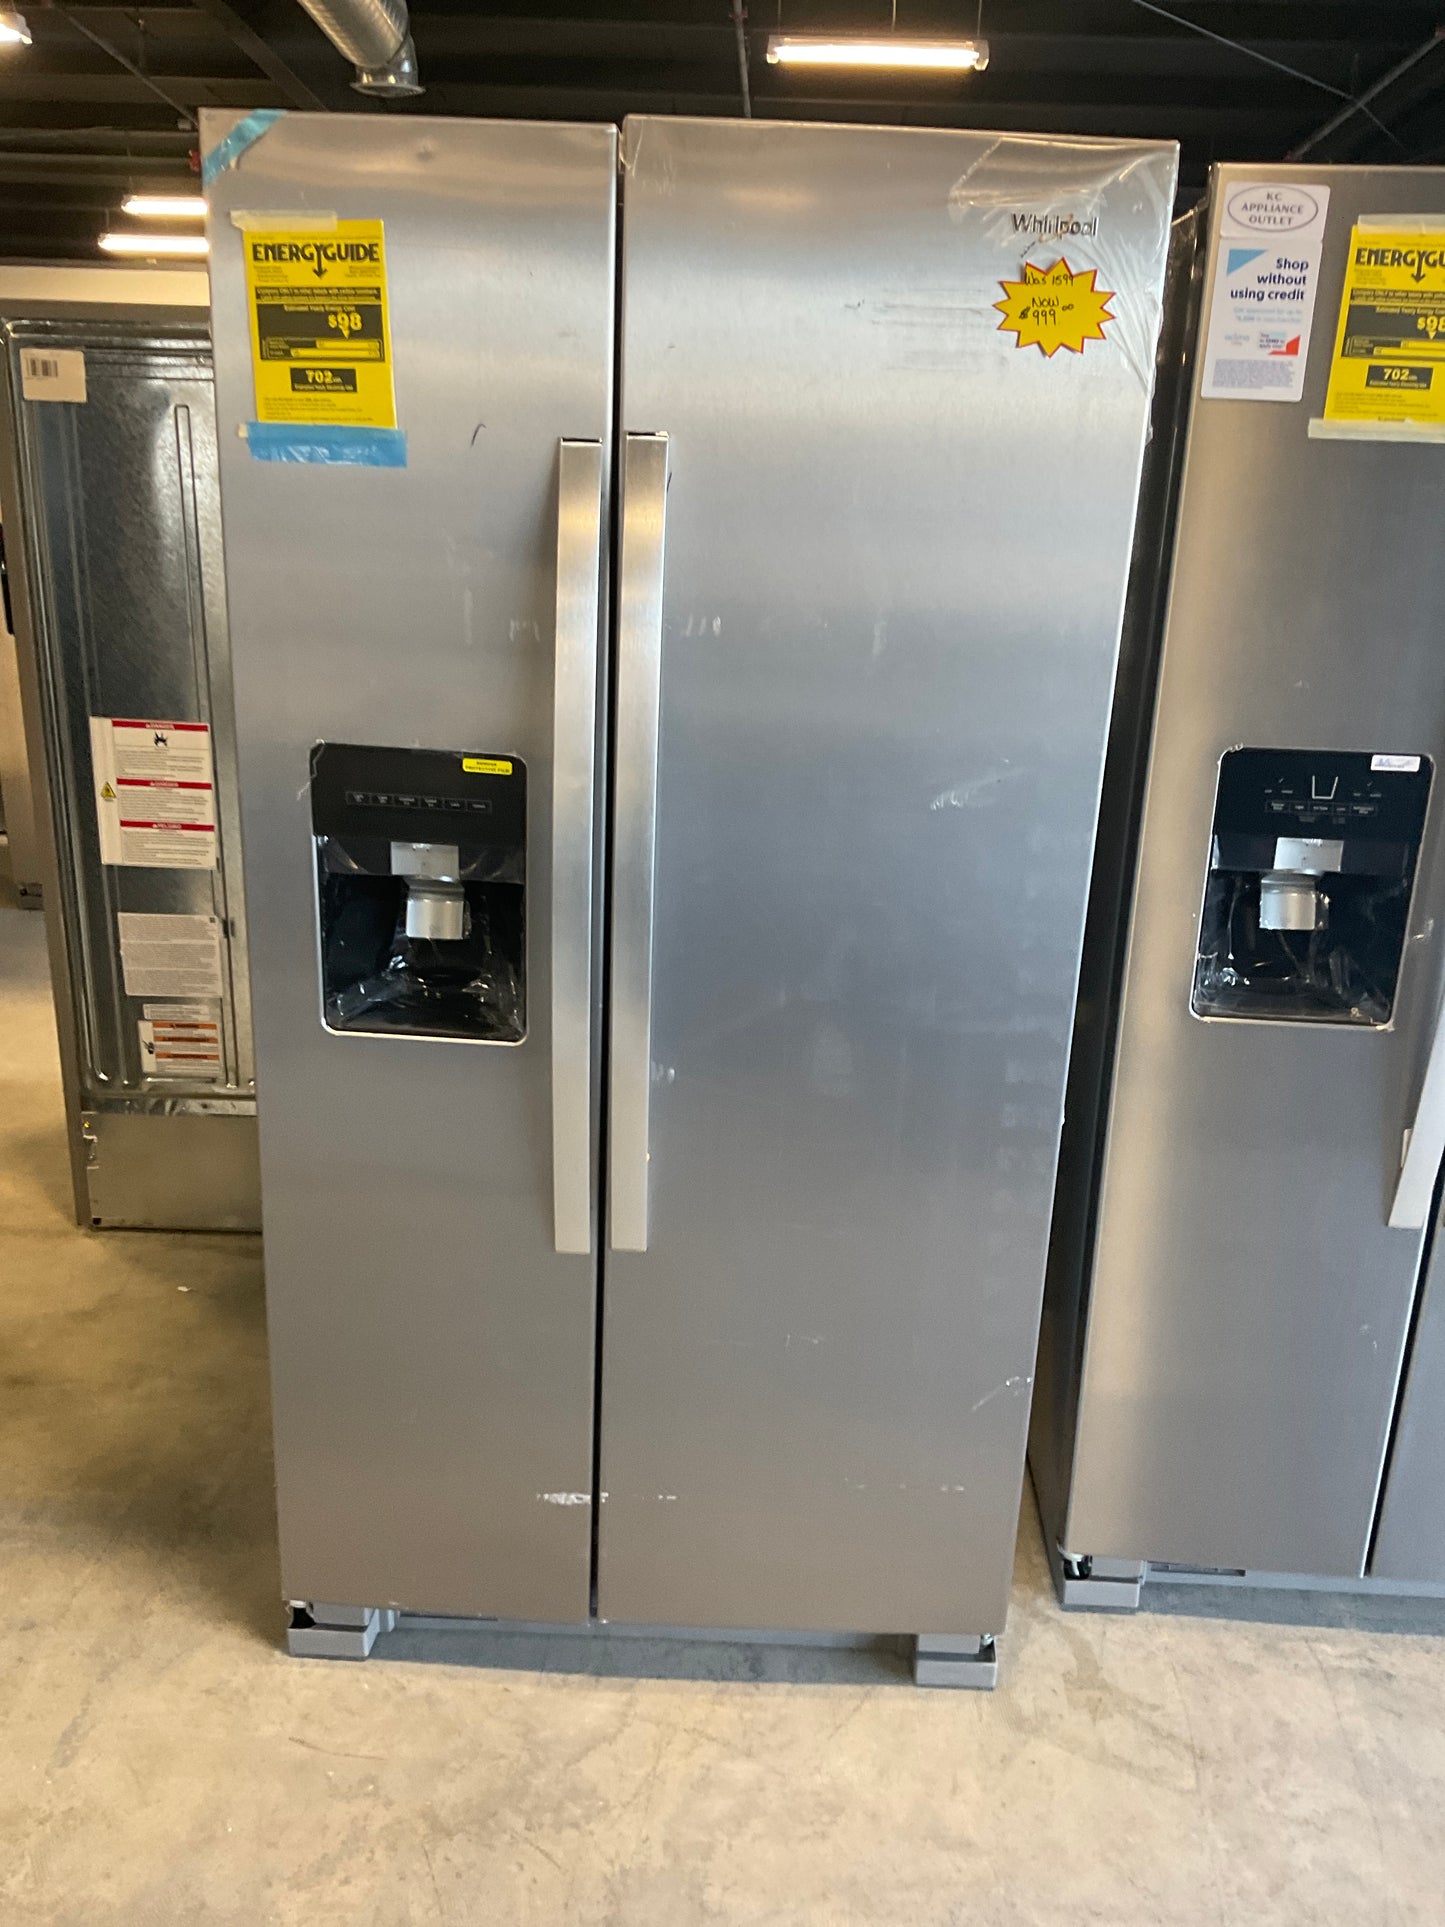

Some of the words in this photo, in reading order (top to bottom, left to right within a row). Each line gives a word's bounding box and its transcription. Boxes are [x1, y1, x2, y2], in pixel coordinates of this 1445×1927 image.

[1266, 192, 1283, 201] KC
[1241, 202, 1304, 215] APPLIANCE
[1011, 212, 1098, 239] Whirlpool
[1248, 214, 1294, 226] OUTLET
[1275, 257, 1310, 273] Shop
[1256, 272, 1307, 286] without
[1230, 286, 1265, 302] using
[1267, 288, 1305, 301] credit
[328, 312, 363, 331] $98
[305, 369, 334, 384] 702
[1383, 368, 1410, 381] 702
